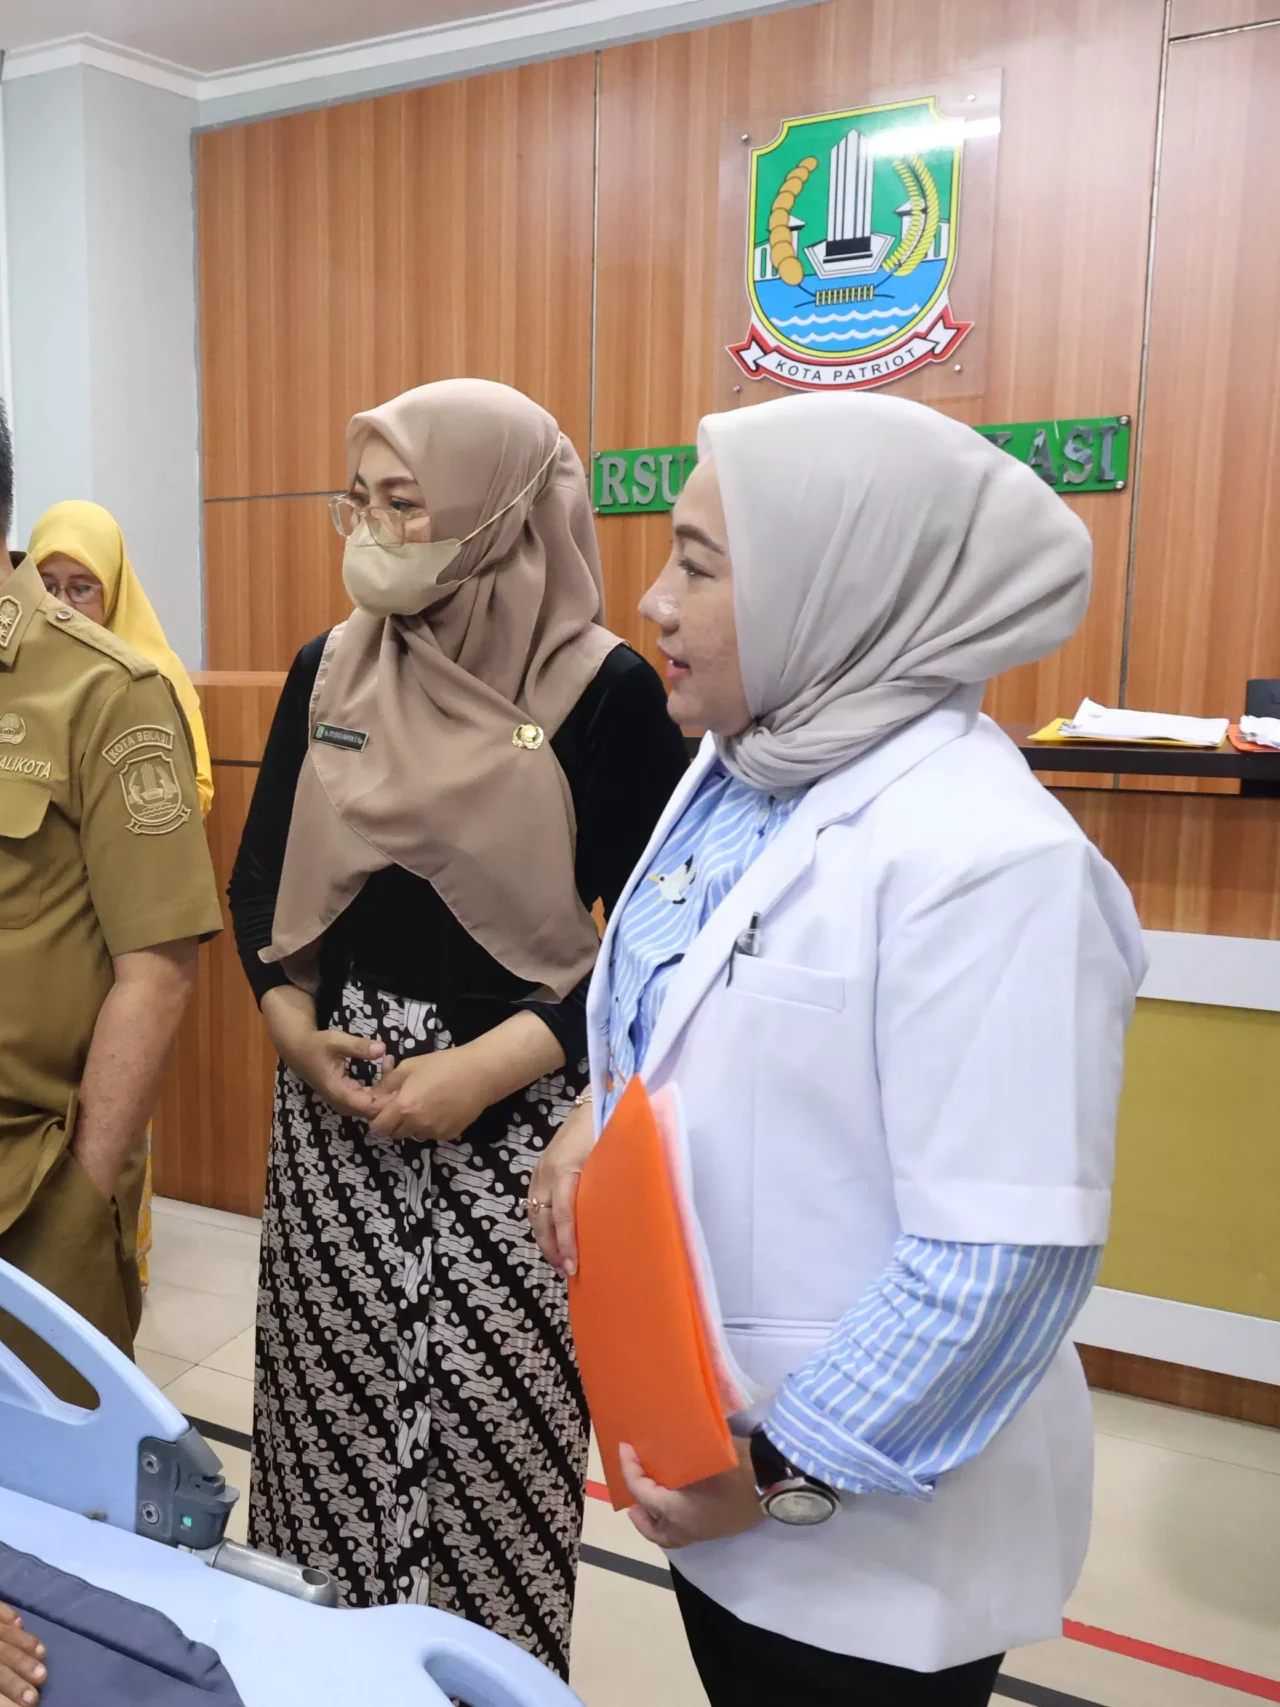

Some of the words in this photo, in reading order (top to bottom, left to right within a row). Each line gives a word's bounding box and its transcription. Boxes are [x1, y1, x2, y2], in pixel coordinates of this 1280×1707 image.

[775, 359, 822, 381] KOTA
[833, 347, 916, 381] PATRIOT
[108, 736, 136, 759] KOTA
[136, 730, 169, 744] BEKASI
